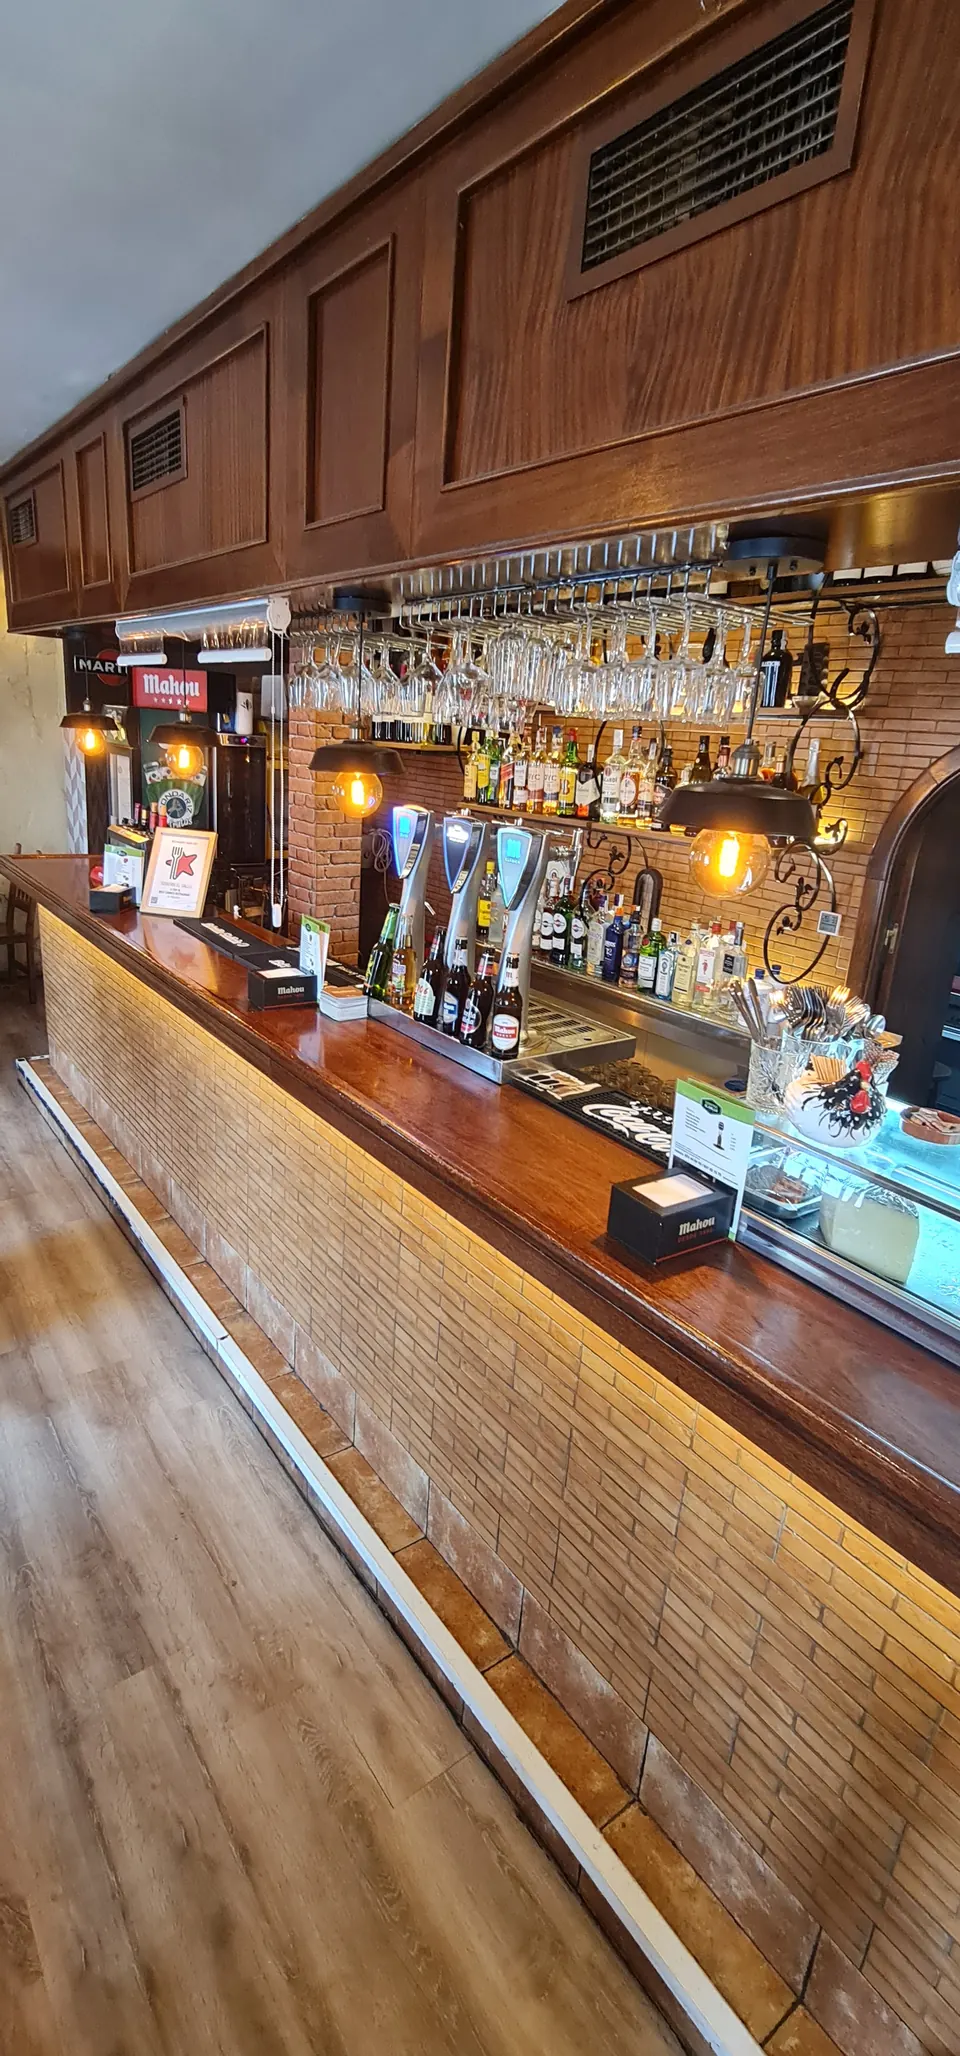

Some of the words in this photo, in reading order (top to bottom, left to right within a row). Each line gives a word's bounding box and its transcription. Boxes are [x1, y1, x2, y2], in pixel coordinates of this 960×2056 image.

[142, 673, 200, 697] Mahou
[160, 790, 193, 815] ONDARIZ
[278, 985, 305, 995] Mahou
[679, 1216, 716, 1236] Mahou
